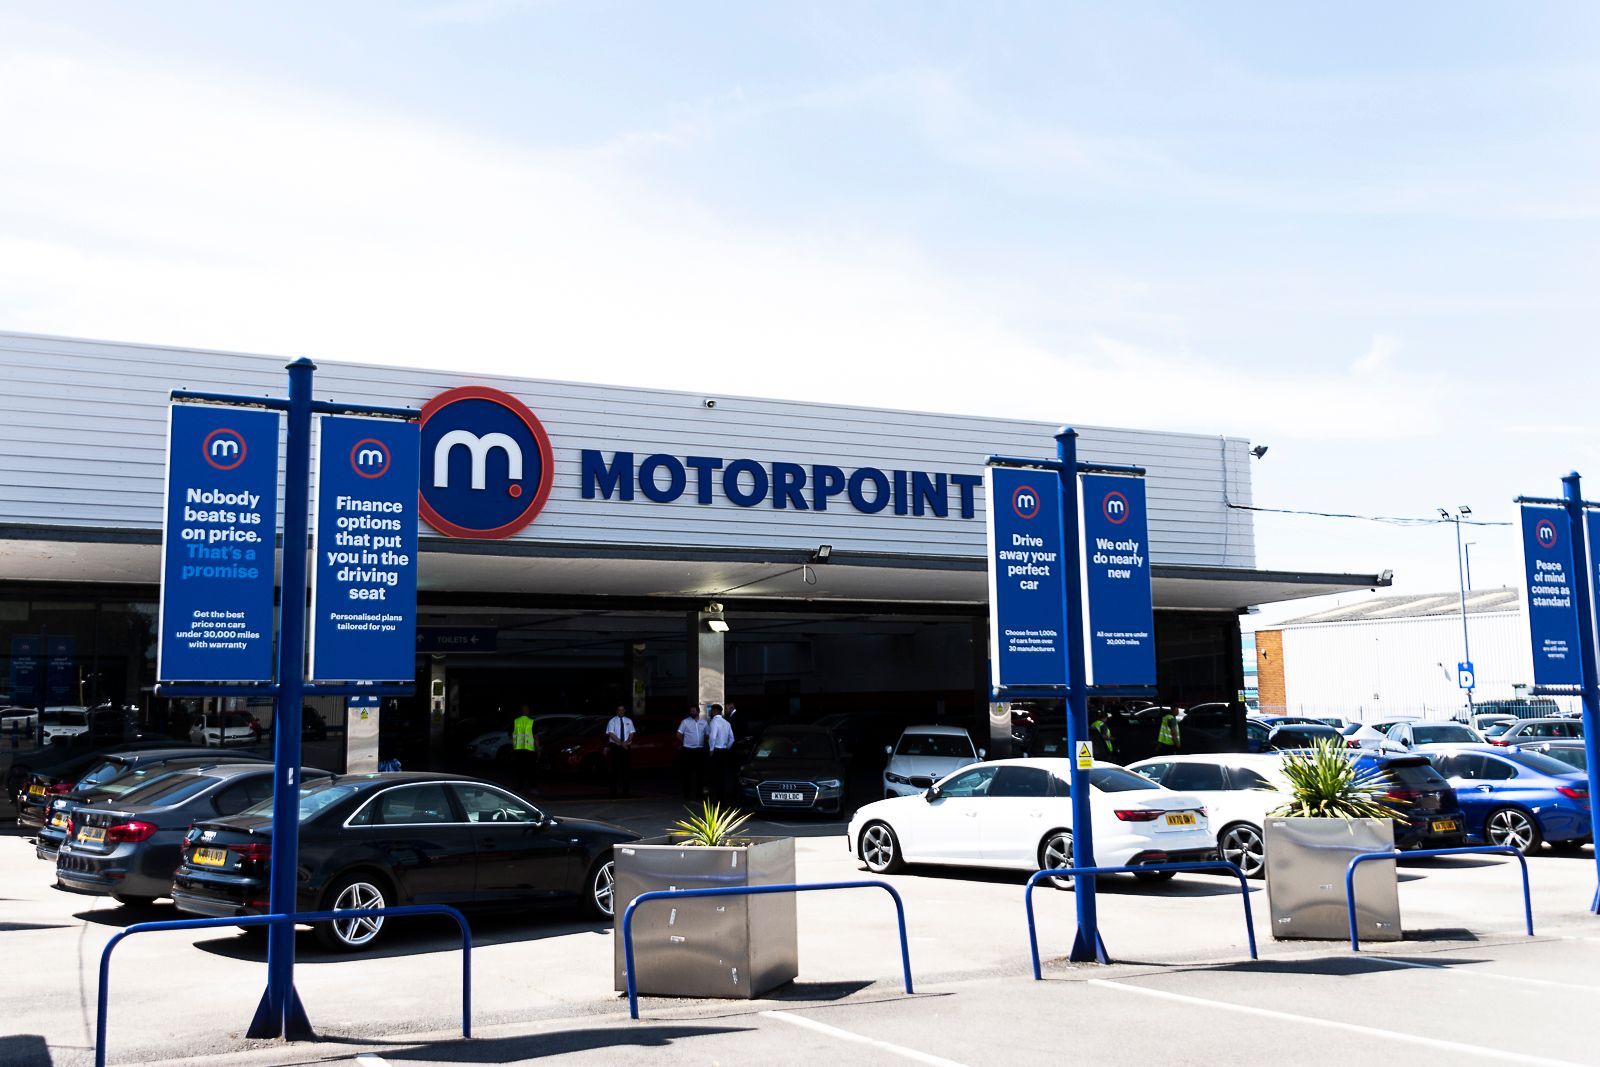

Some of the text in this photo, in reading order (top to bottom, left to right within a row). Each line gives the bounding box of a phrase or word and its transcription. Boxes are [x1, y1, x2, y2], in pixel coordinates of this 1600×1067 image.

[581, 449, 983, 519] MOTORPOINT
[186, 488, 260, 509] Nobody
[336, 496, 403, 513] Finance
[184, 506, 261, 524] beats us
[337, 514, 401, 531] options
[181, 526, 262, 544] on price.
[335, 530, 402, 550] that put
[1012, 534, 1043, 547] Drive
[186, 542, 256, 560] That's a
[1096, 538, 1139, 553] We only
[327, 548, 409, 566] you in the
[999, 550, 1056, 563] away your
[1093, 553, 1143, 567] do nearly
[182, 563, 258, 580] promise
[1008, 562, 1050, 577] perfect
[1536, 560, 1562, 571] Peace
[337, 566, 398, 586] driving
[1108, 569, 1131, 578] new
[1534, 571, 1566, 583] of mind
[1020, 580, 1039, 590] car
[1531, 586, 1570, 595] comes as
[349, 588, 386, 600] seat
[1533, 596, 1570, 607] standard
[226, 610, 245, 618] best
[330, 612, 402, 622] Personalised plans
[191, 620, 214, 629] price
[368, 622, 380, 630] for
[203, 630, 236, 638] 30,000
[437, 636, 468, 644] TOILETS
[209, 642, 247, 650] warranty
[1460, 671, 1473, 688] D
